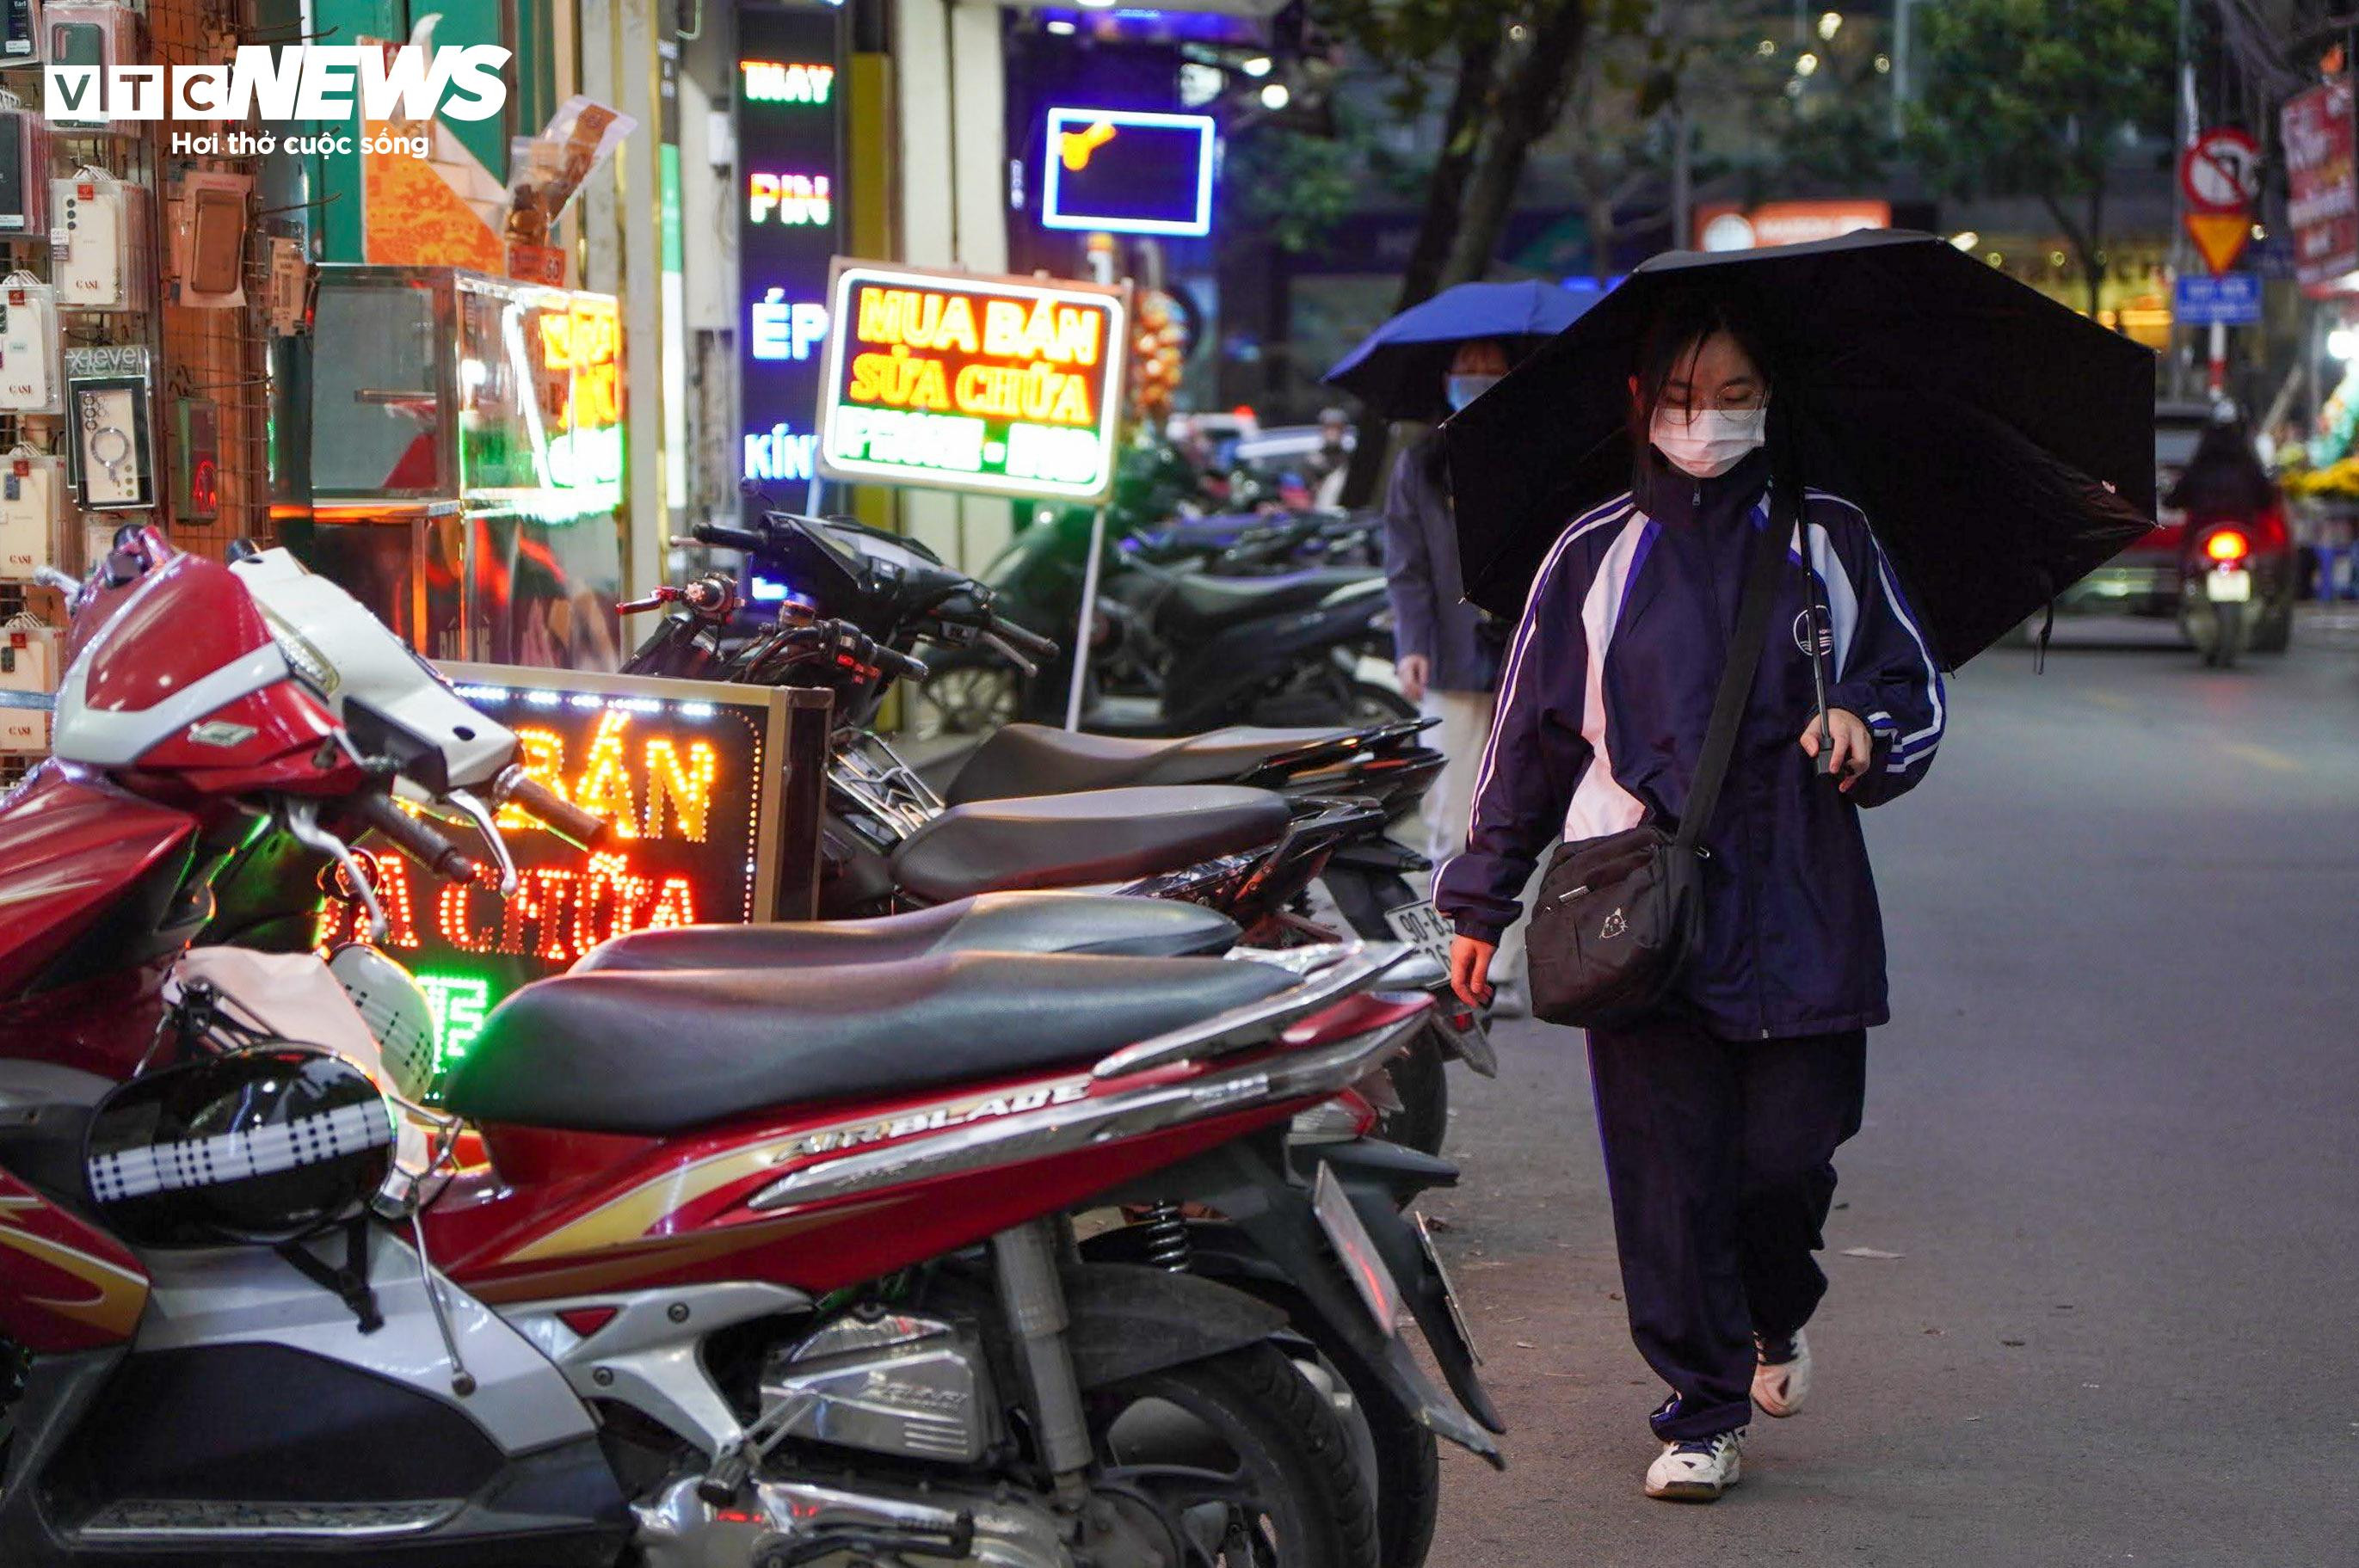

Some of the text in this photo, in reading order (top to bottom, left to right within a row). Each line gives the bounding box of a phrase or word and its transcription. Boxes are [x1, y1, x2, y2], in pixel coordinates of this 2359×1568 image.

[750, 173, 829, 225] PIN
[752, 287, 829, 360] ÉP
[857, 286, 1102, 366] MUA BÁN
[849, 343, 1094, 427] SỬA CHỮA
